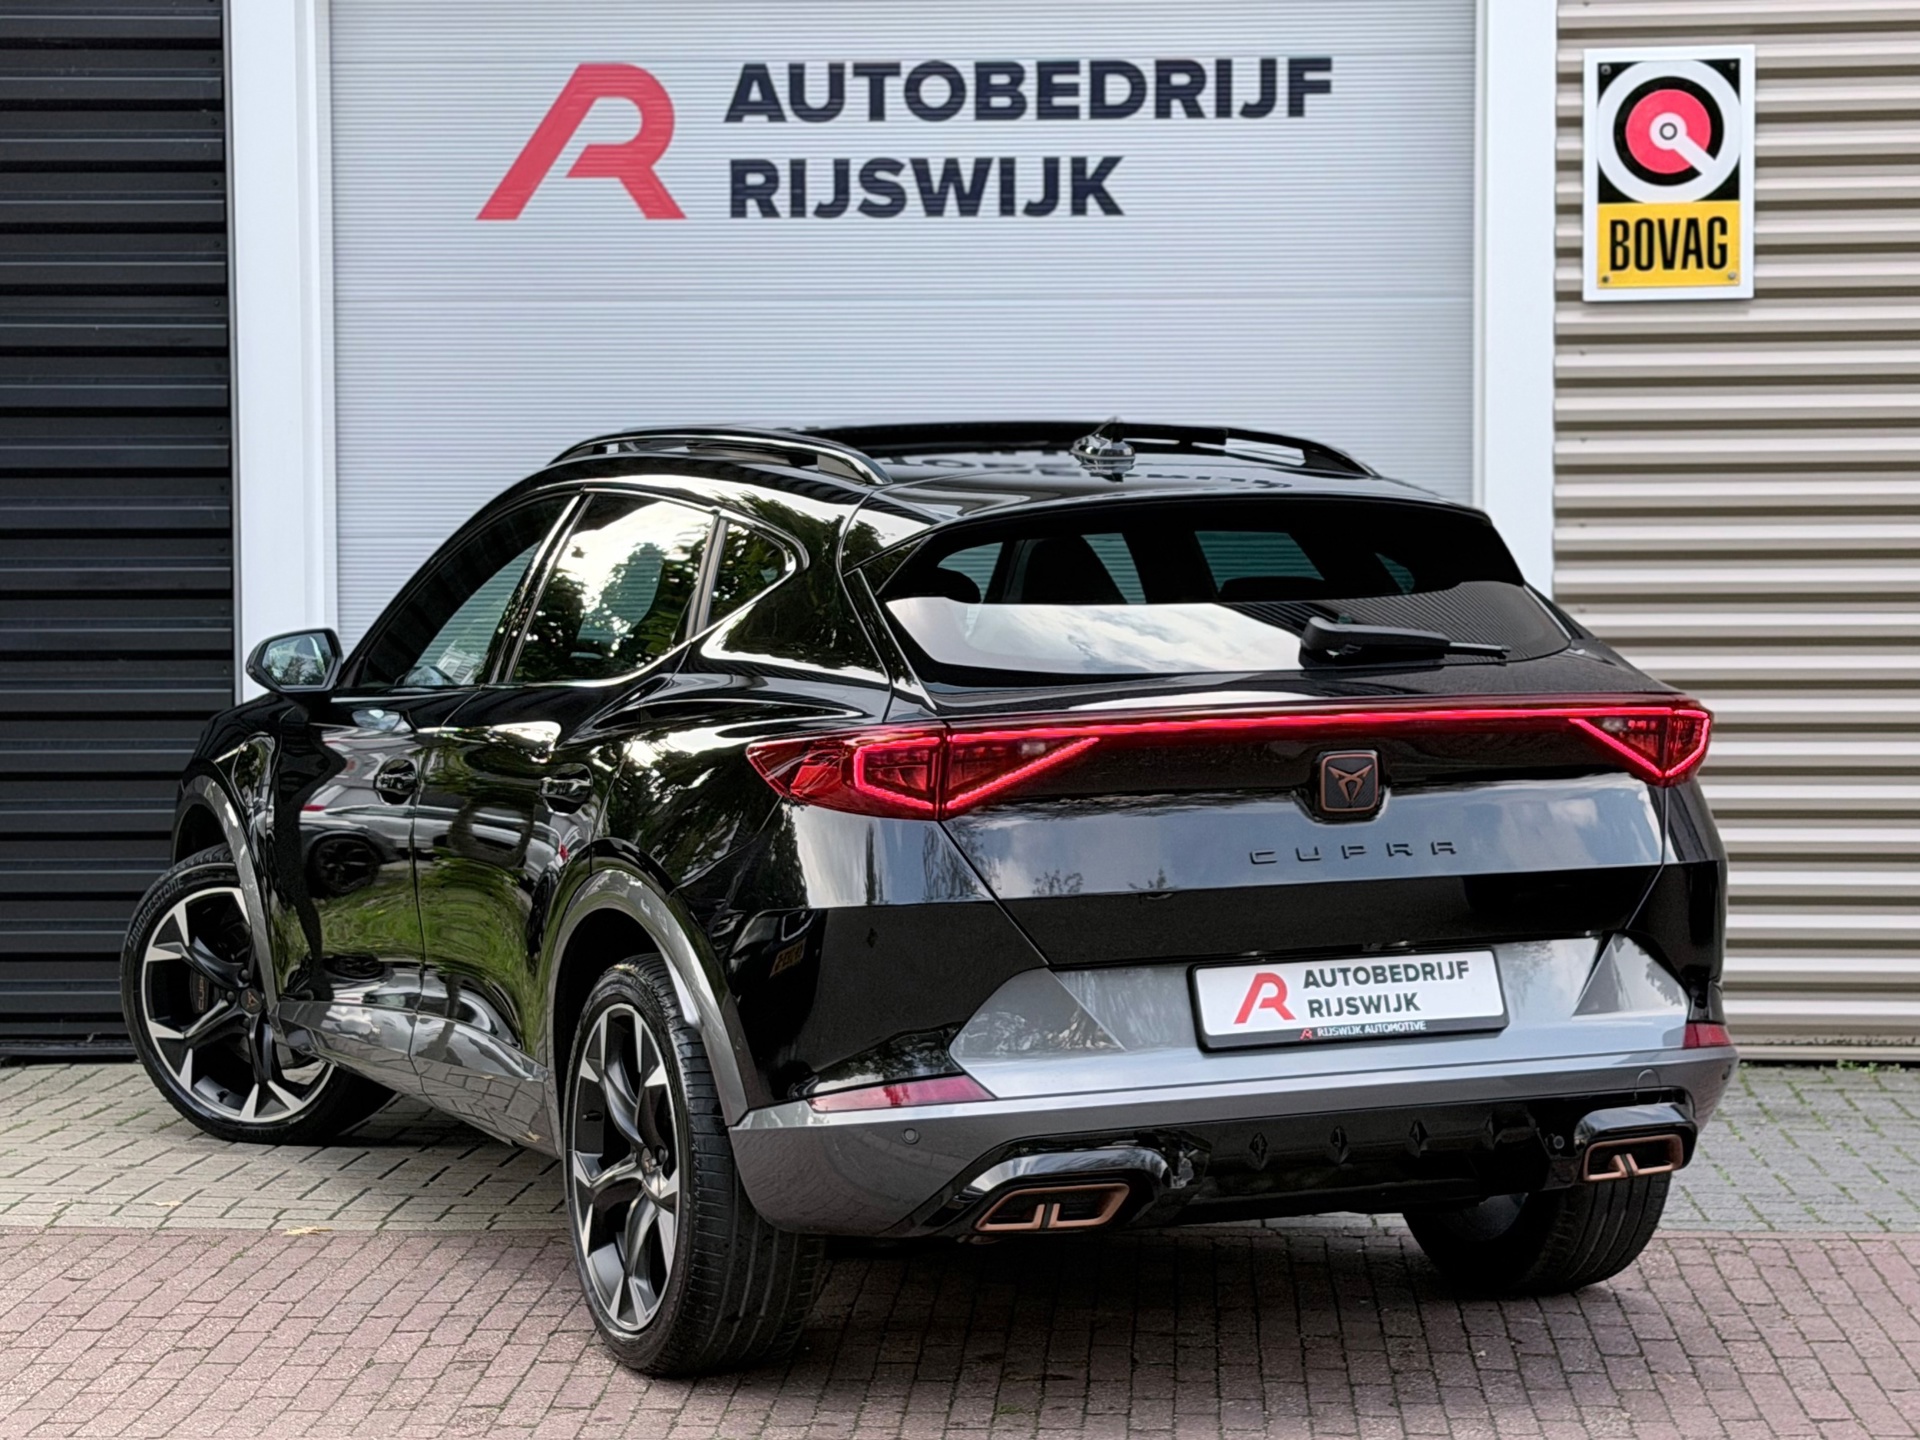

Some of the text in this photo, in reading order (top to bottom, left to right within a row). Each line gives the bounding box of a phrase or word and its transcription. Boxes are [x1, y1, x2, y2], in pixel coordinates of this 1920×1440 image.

[724, 56, 1333, 123] AUTOBEDRIJF
[729, 156, 1125, 219] RIJSWIJK
[1609, 216, 1728, 272] BOVAG
[1249, 841, 1458, 865] CUPRA
[1303, 960, 1470, 989] AUTOBEDRIJF
[1307, 992, 1421, 1018] RIJSWIJK
[1316, 1025, 1363, 1037] RIJSWIJK
[1364, 1020, 1427, 1034] AUTOMOTIVE
